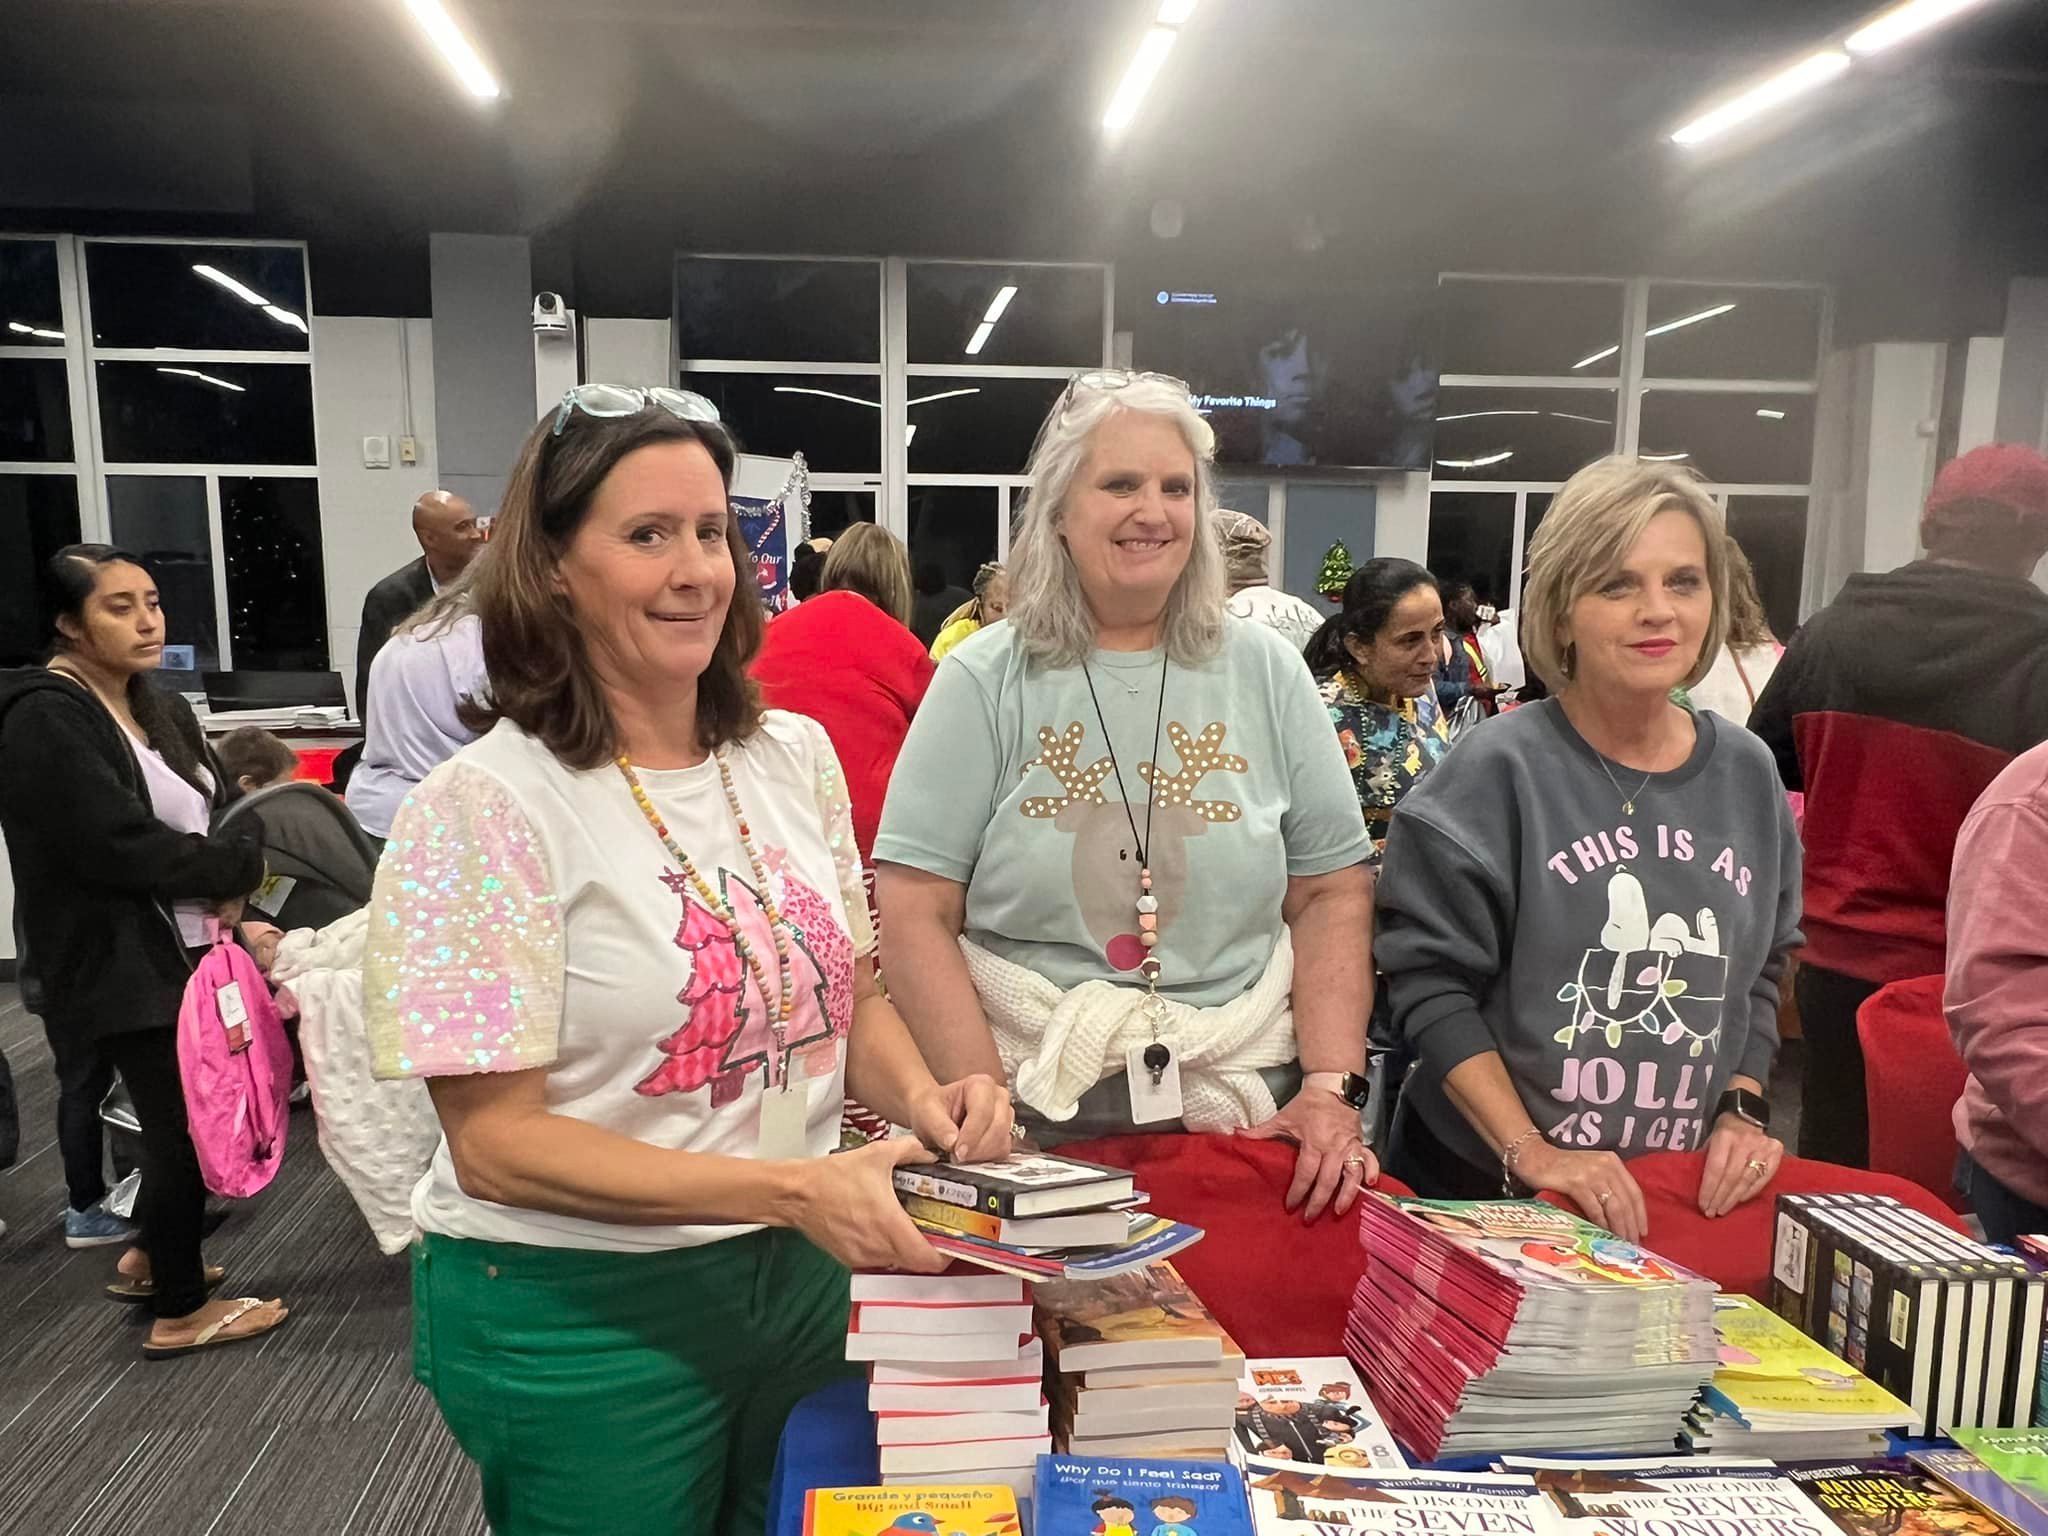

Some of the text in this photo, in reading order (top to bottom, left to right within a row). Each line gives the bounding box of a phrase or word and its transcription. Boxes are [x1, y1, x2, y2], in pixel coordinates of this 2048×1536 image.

[1203, 394, 1242, 407] Favorite
[1244, 396, 1277, 410] Things
[761, 553, 782, 565] Our
[1548, 825, 1752, 897] THIS IS AS
[1548, 1111, 1602, 1147] AS
[1619, 1116, 1635, 1148] I
[1055, 1463, 1221, 1481] Why Do I Feel Sad?
[1379, 1479, 1441, 1489] Wonders
[1446, 1481, 1460, 1489] of
[1672, 1481, 1786, 1495] DISCOVER
[1815, 1478, 1913, 1495] NATURAL
[833, 1490, 993, 1501] Grande y pequeño
[1413, 1495, 1528, 1511] DISCOVER
[1819, 1492, 1938, 1509] DISASTERS
[857, 1500, 972, 1512] Big and Small
[1663, 1496, 1802, 1517] SEVEN
[1394, 1508, 1536, 1535] SEVEN
[1600, 1518, 1823, 1536] WONDERS
